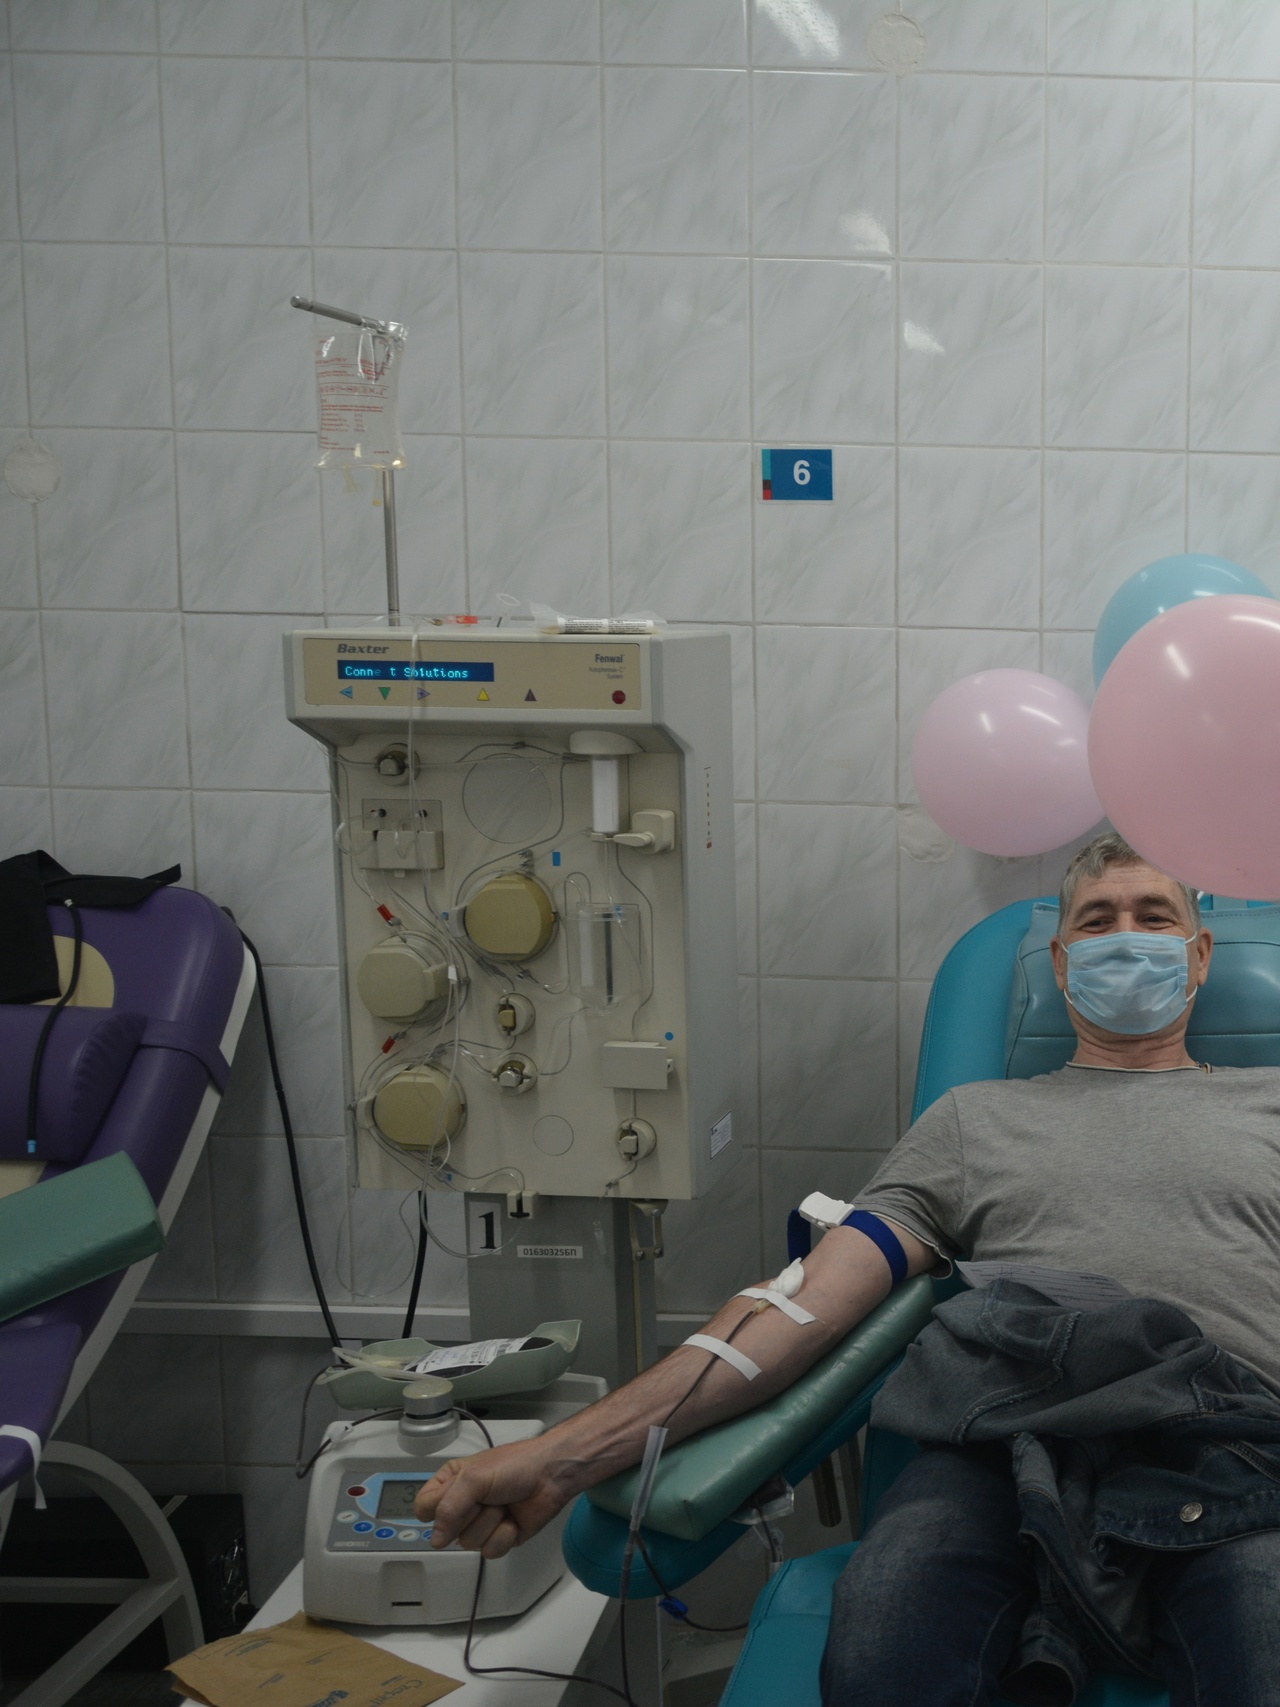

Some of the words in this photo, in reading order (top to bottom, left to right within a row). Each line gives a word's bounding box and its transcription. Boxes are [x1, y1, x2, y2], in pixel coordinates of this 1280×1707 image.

[793, 459, 811, 485] 6
[337, 643, 390, 654] Baxter
[594, 653, 624, 663] Fenwal
[403, 666, 469, 679] Solutions
[478, 1211, 497, 1250] 1
